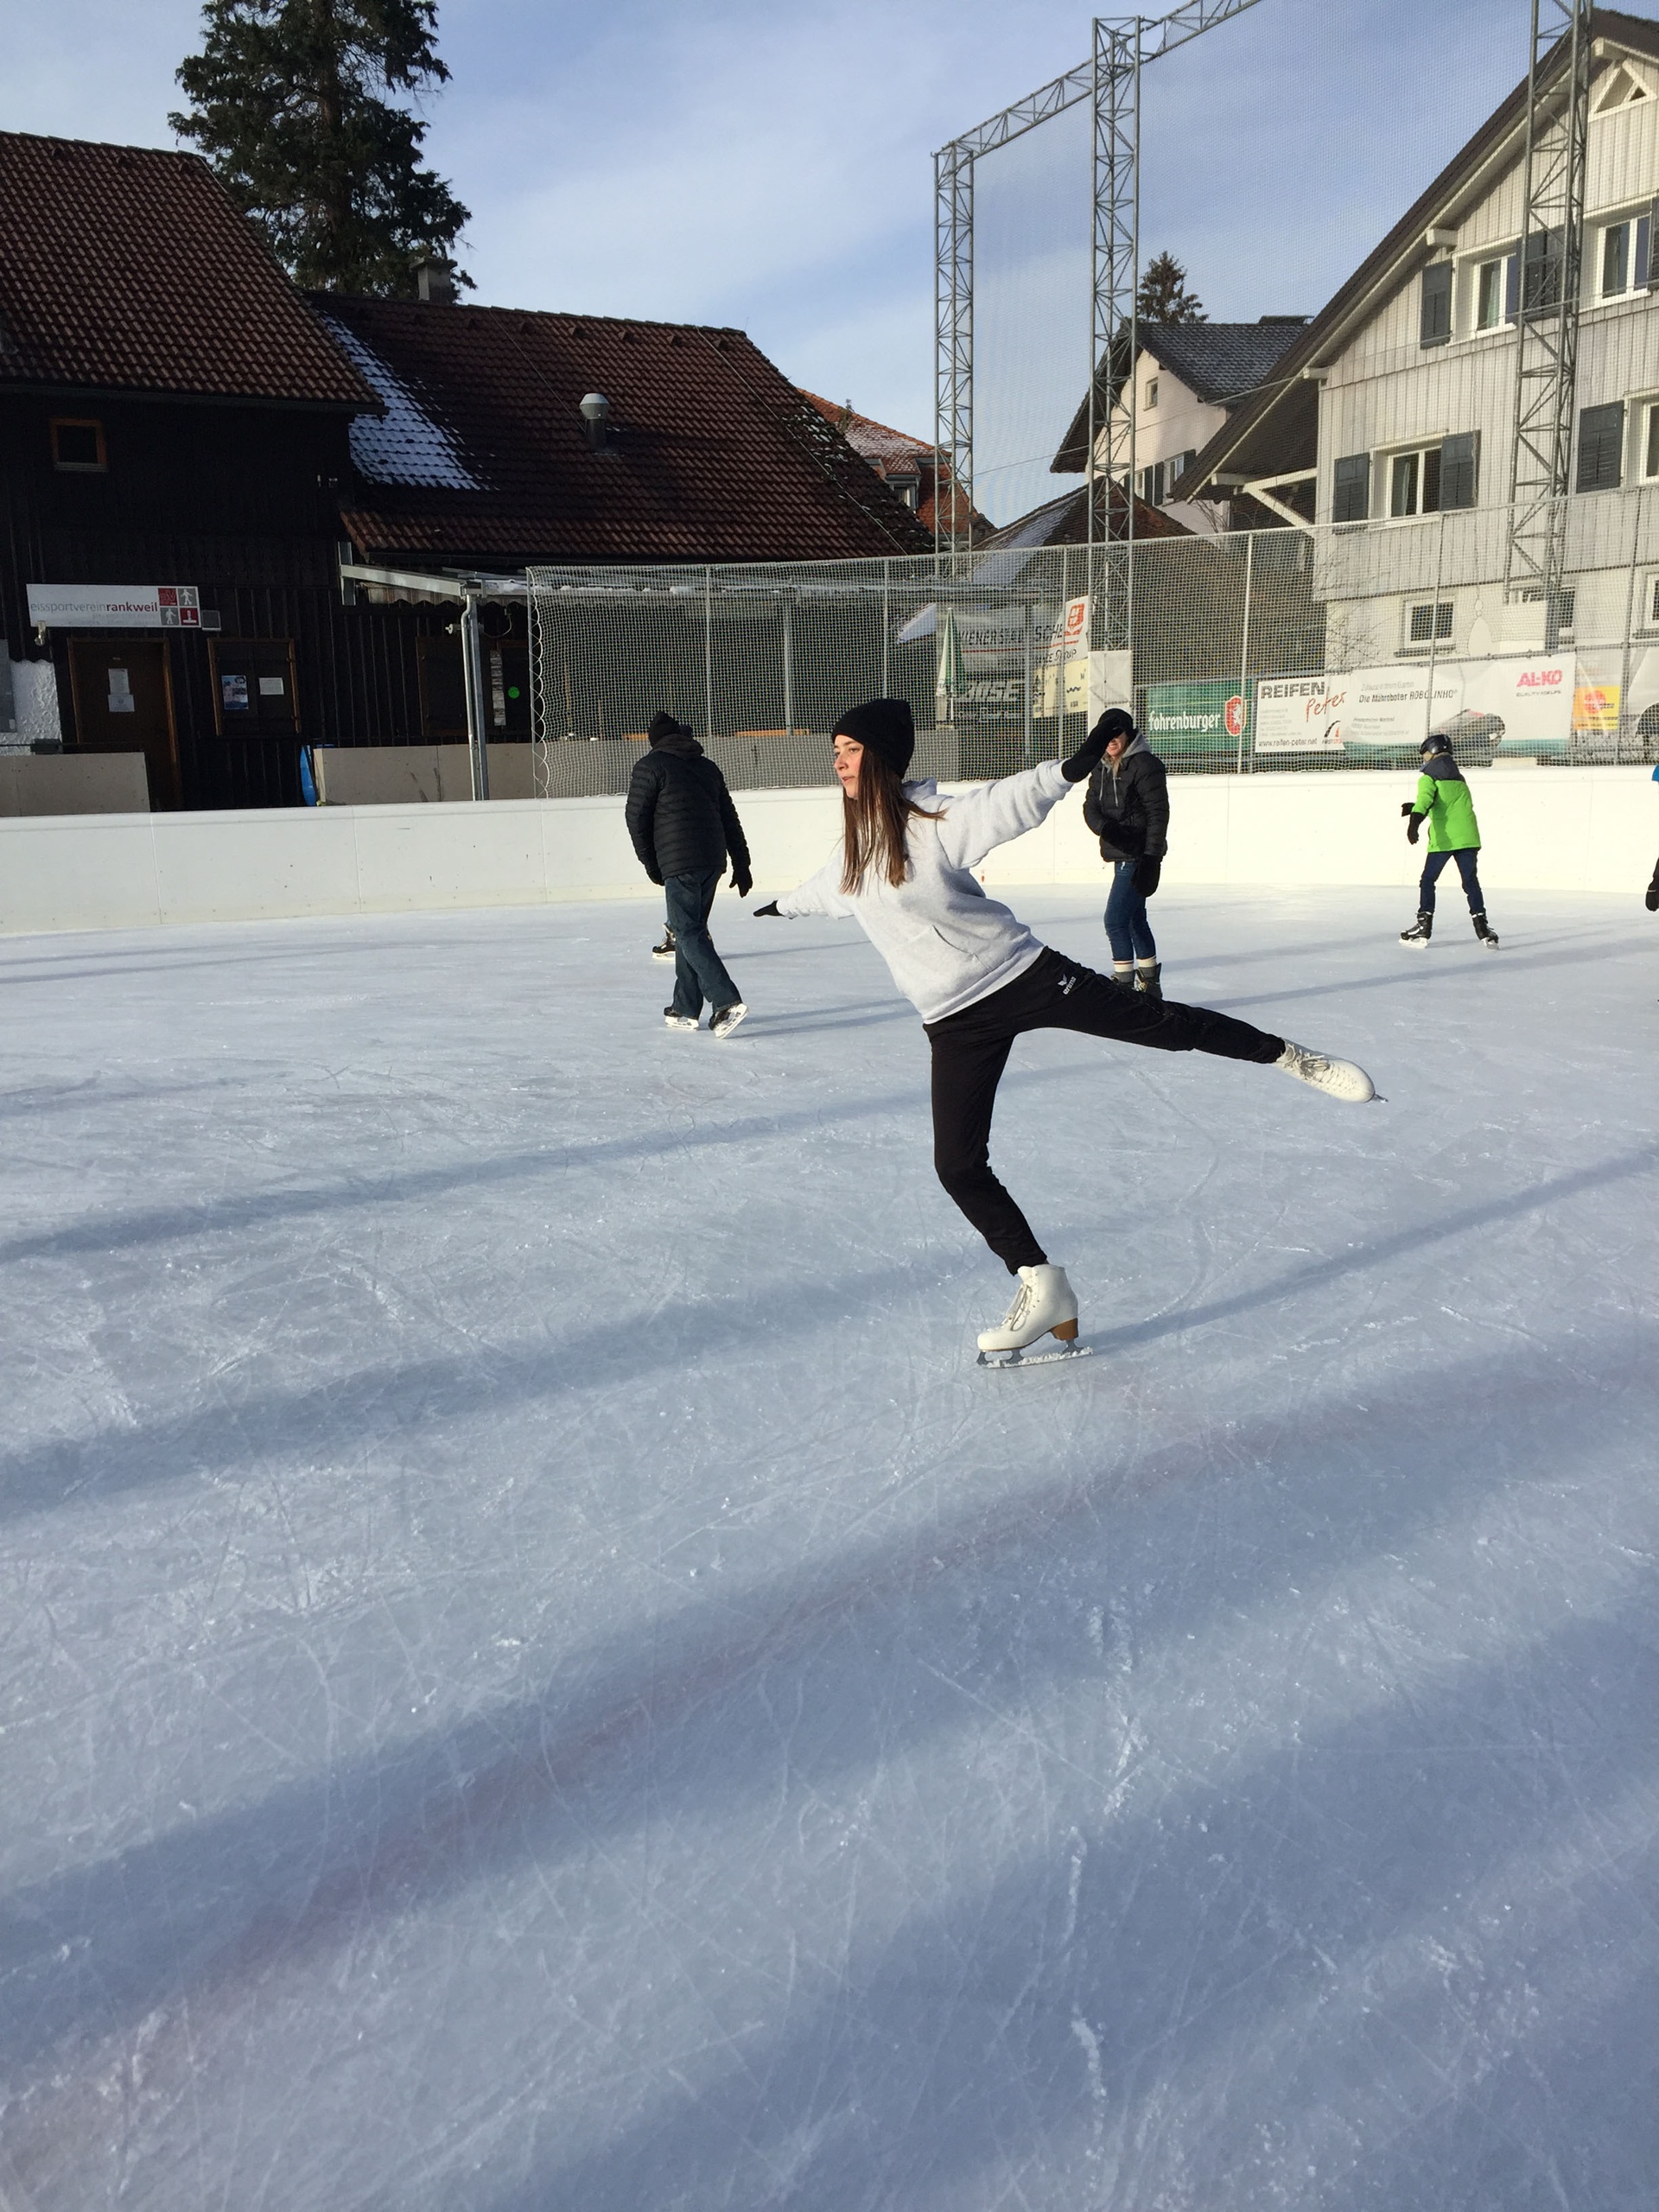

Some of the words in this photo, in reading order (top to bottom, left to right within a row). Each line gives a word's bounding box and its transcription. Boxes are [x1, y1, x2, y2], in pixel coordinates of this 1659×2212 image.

[1516, 669, 1563, 688] AL-KO
[1261, 681, 1325, 700] REIFEN
[1358, 694, 1370, 703] Die
[1306, 686, 1348, 722] Peter
